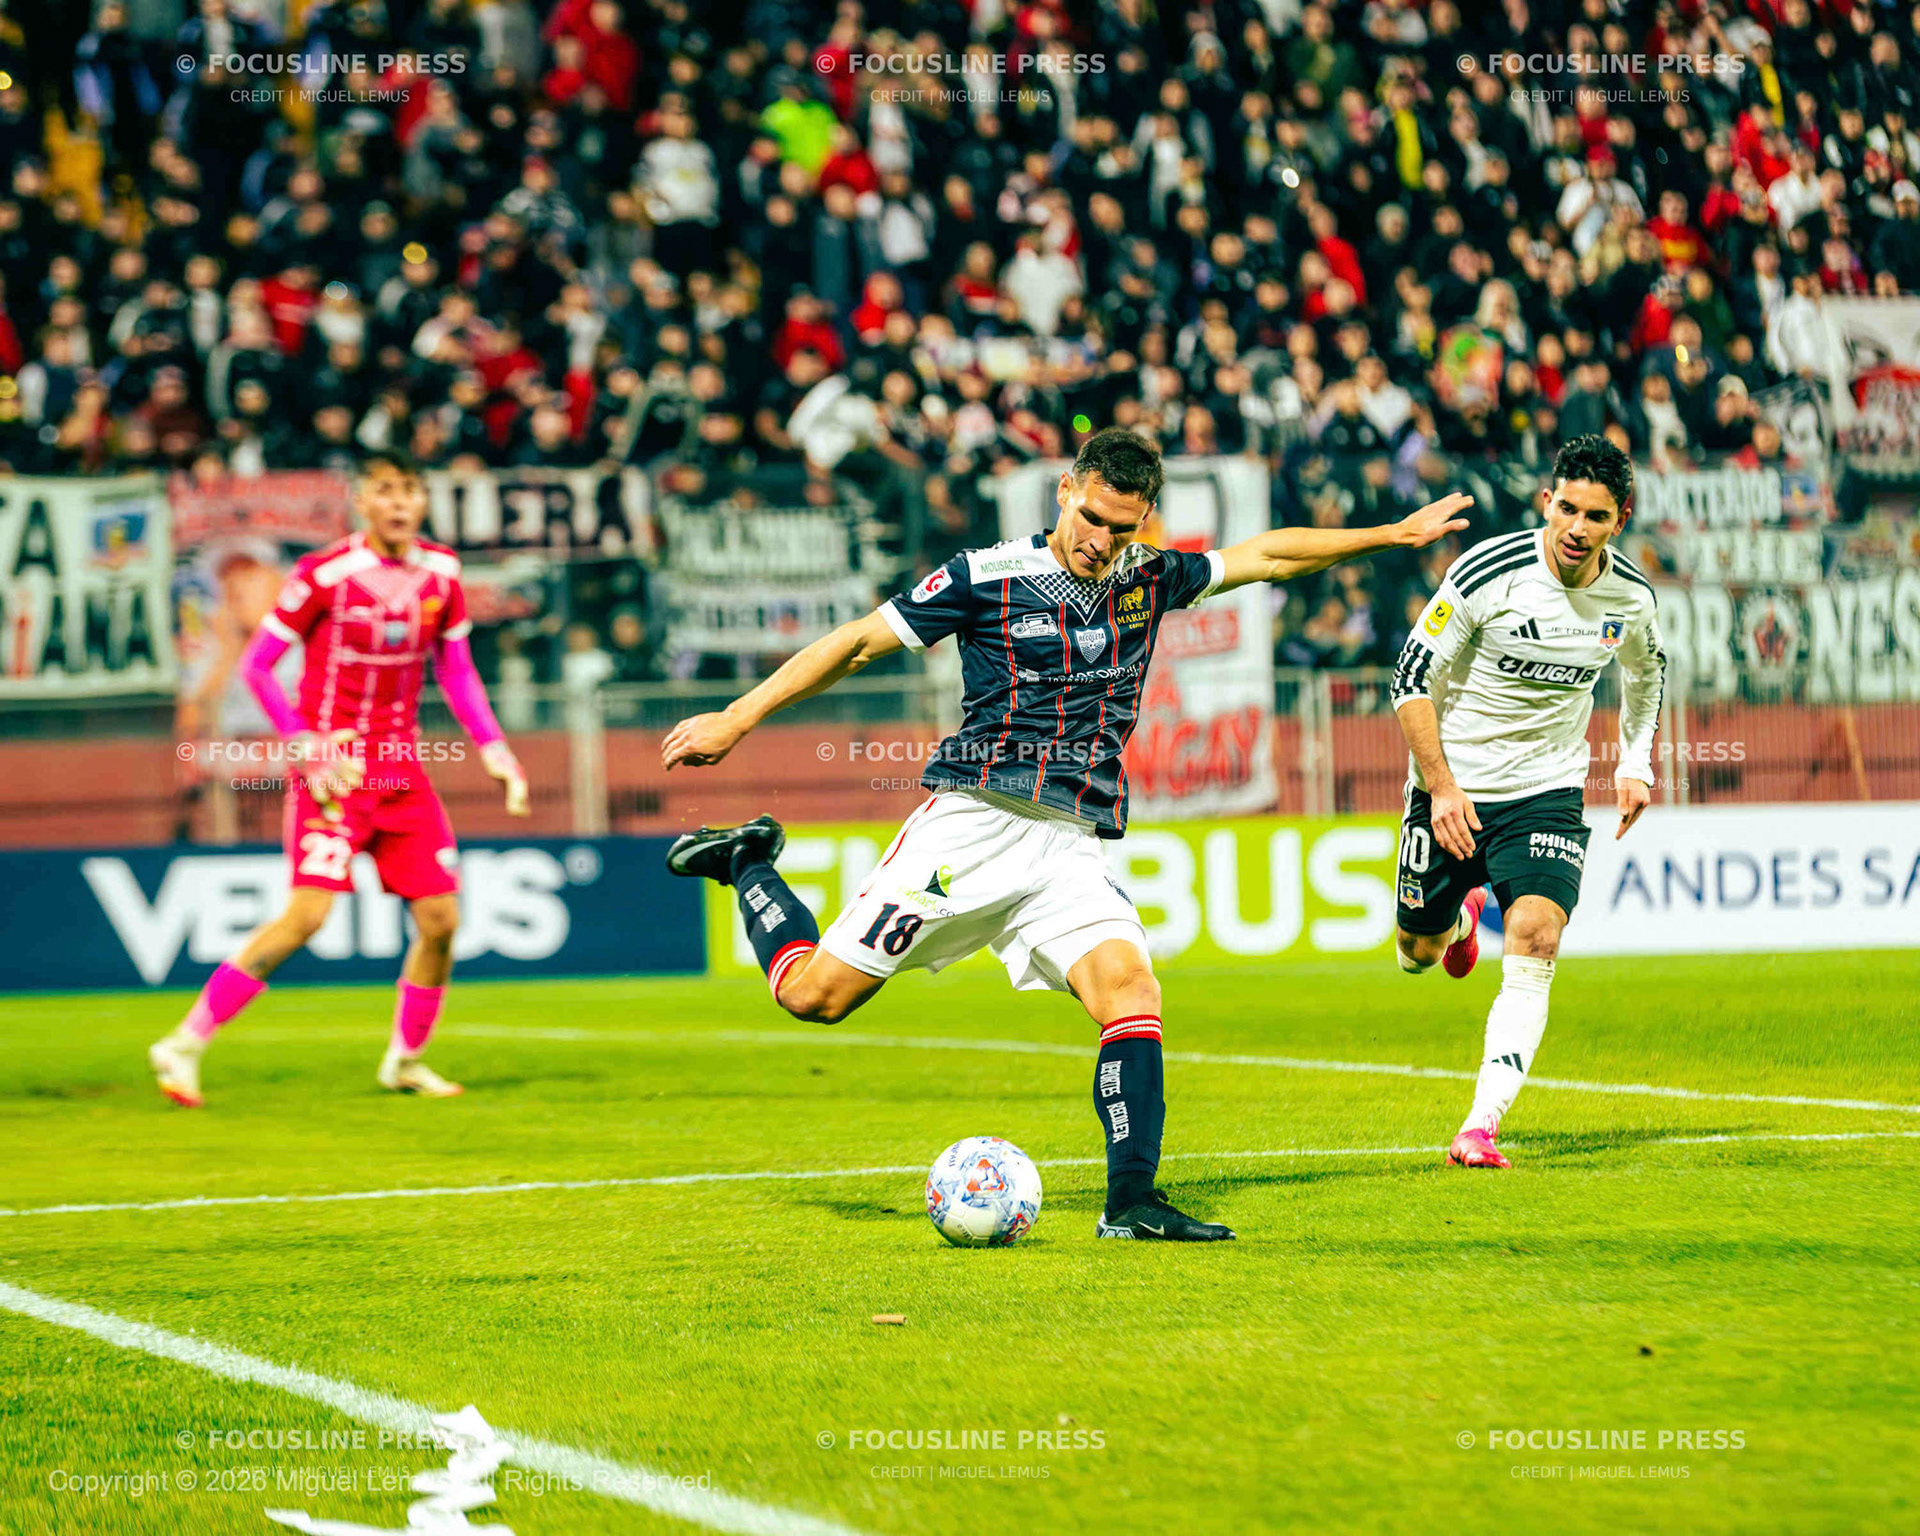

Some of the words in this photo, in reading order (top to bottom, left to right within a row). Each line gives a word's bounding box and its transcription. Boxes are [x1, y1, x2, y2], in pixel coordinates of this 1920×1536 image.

[1545, 626, 1599, 637] JETOUR
[1529, 846, 1546, 858] TV
[1610, 848, 1843, 912] ANDES
[858, 902, 924, 956] 18
[1100, 1060, 1122, 1098] DEPORTES
[1106, 1100, 1130, 1144] RECOLETA
